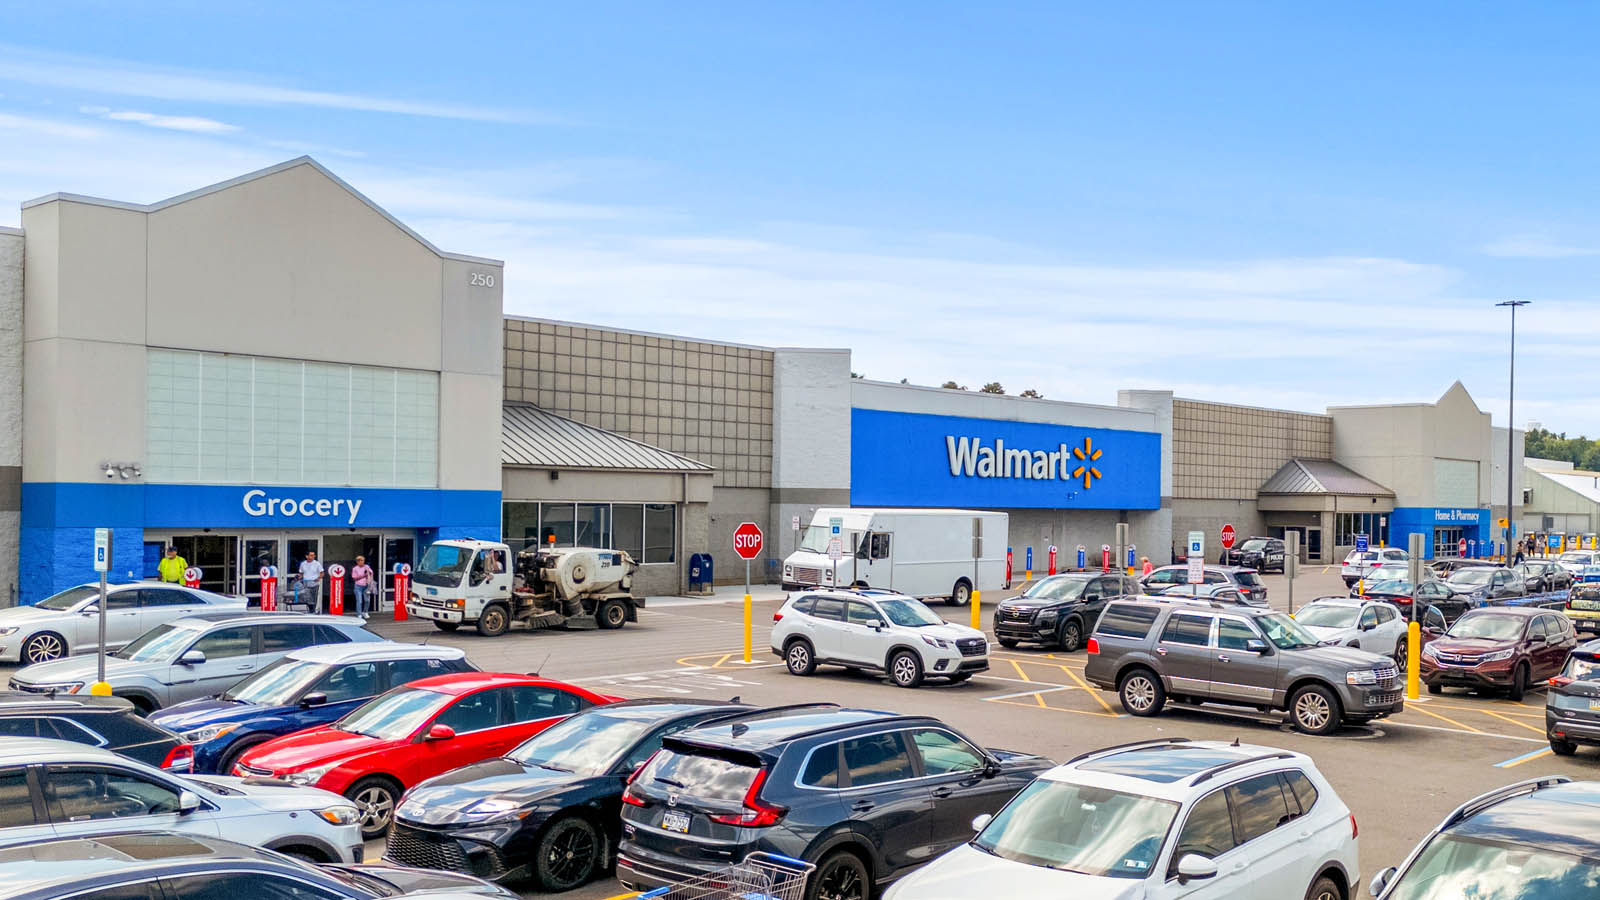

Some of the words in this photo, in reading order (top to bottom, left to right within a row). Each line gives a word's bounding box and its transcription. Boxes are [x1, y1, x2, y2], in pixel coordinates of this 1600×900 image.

[471, 272, 494, 287] 250
[946, 435, 1070, 480] Walmart
[243, 489, 362, 524] Grocery
[1435, 509, 1450, 520] Home
[1451, 509, 1455, 520] &
[1456, 510, 1479, 524] Pharmacy
[736, 534, 760, 548] STOP
[1222, 532, 1234, 541] STOP
